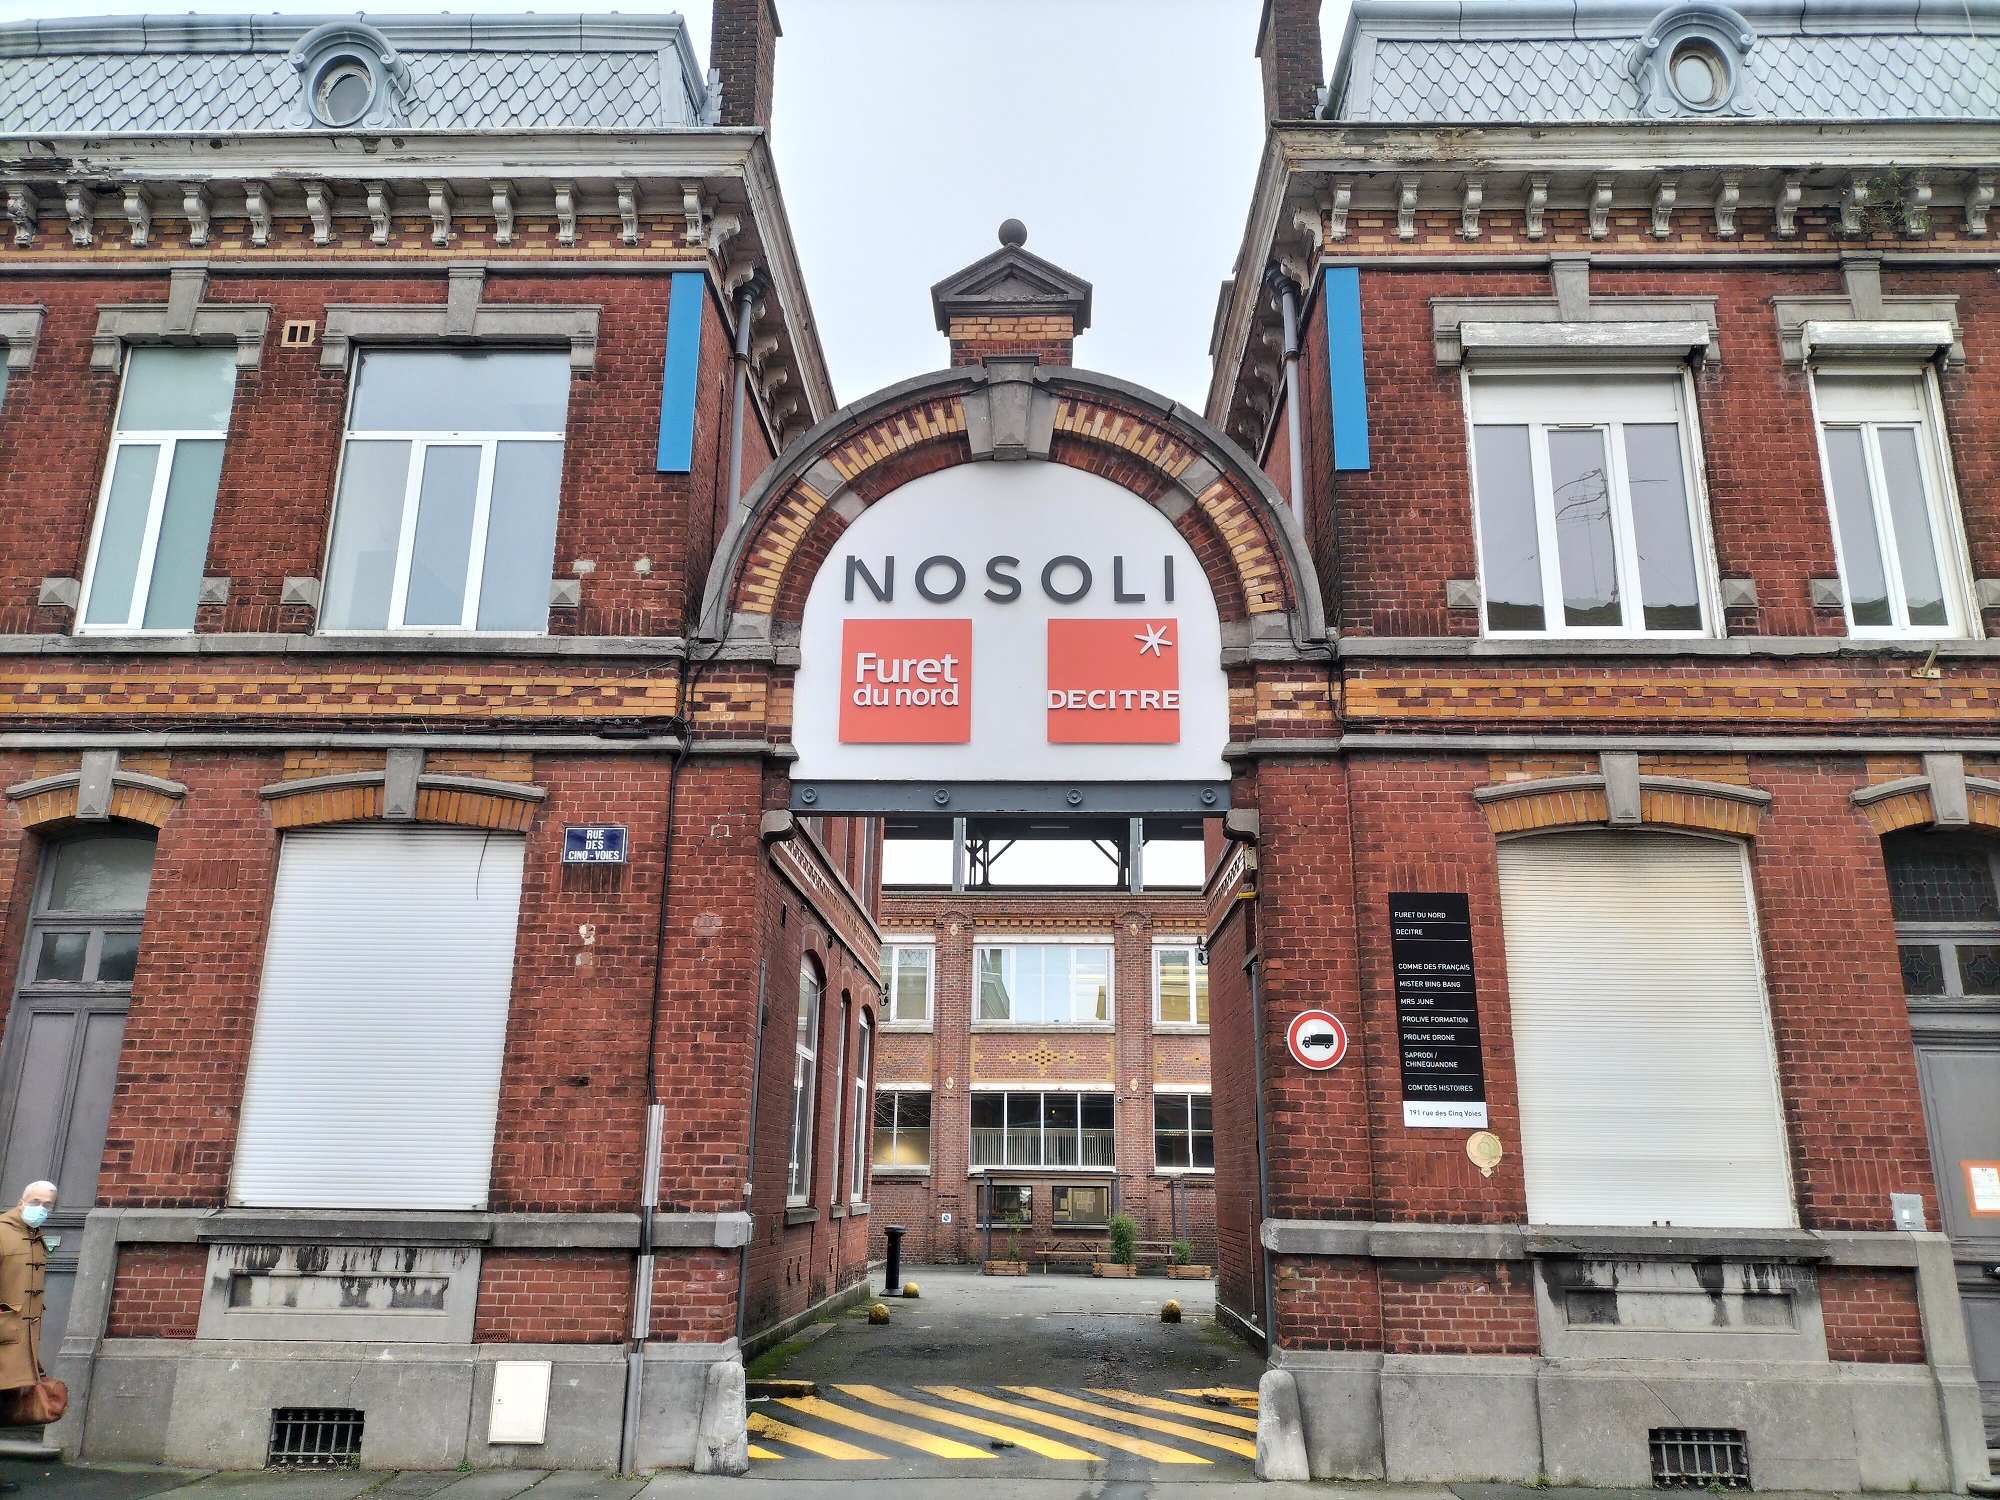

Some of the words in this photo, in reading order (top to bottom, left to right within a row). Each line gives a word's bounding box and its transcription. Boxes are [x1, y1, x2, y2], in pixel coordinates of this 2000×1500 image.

[844, 554, 1175, 604] NOSOLI
[855, 652, 959, 684] Furet
[852, 683, 889, 707] du
[894, 683, 959, 707] nord
[1047, 689, 1180, 710] DECITRE
[586, 829, 605, 840] RUE
[585, 840, 604, 850] DES
[1394, 911, 1416, 919] FURET
[1395, 928, 1424, 936] DECITRE
[1437, 963, 1471, 972] FRANÇAIS
[1402, 1015, 1430, 1023] PROLIVE
[1430, 1016, 1469, 1024] FORMATION
[1403, 1033, 1431, 1041] PROLIVE
[1404, 1051, 1434, 1059] SAPRODI
[1405, 1060, 1459, 1068] CHINEQUANONE
[1438, 1084, 1474, 1092] HISTOIRES
[1435, 1109, 1447, 1117] des
[1448, 1110, 1463, 1118] Cinq
